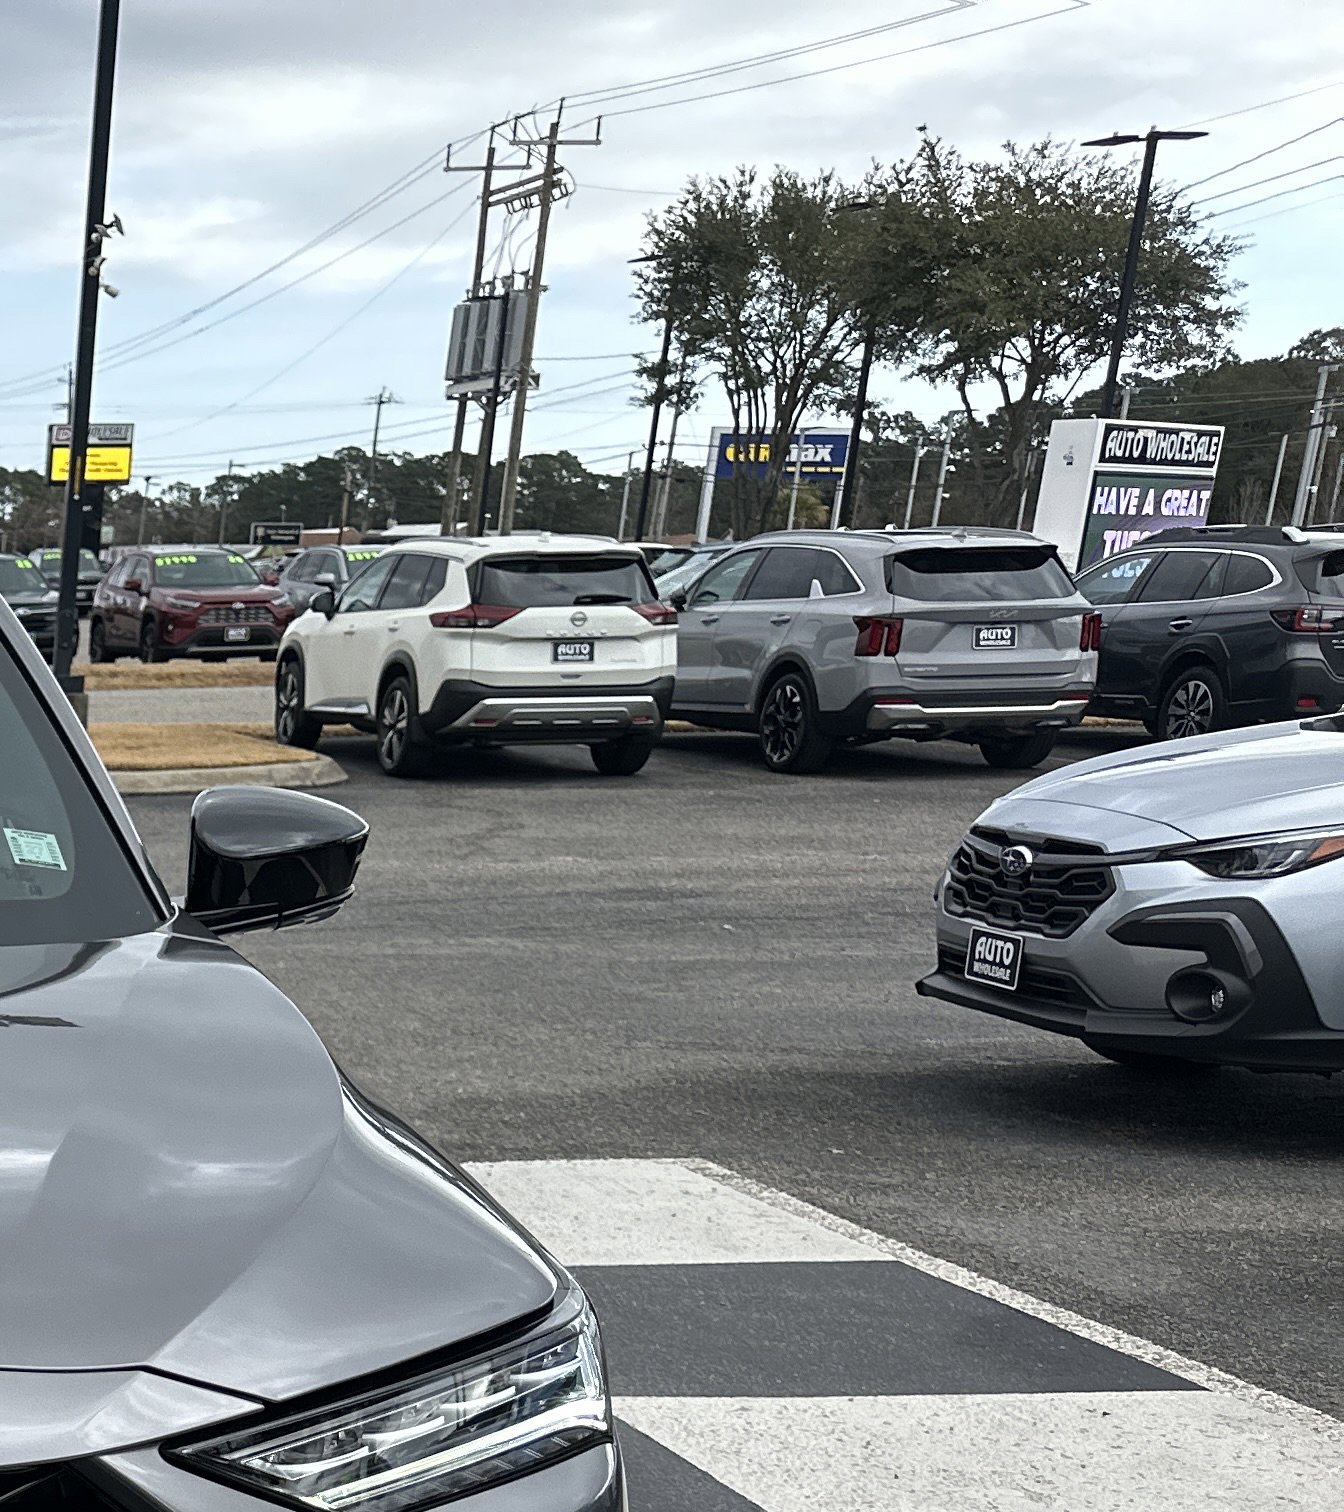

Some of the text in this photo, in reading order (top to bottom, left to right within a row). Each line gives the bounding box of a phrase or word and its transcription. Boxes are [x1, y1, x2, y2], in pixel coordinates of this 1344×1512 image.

[1105, 429, 1219, 463] AUTO WHOLESALE
[1092, 486, 1211, 517] HAVE A GREAT
[557, 643, 590, 655] AUTO
[979, 628, 1012, 640] AUTO
[974, 936, 1015, 966] AUTO
